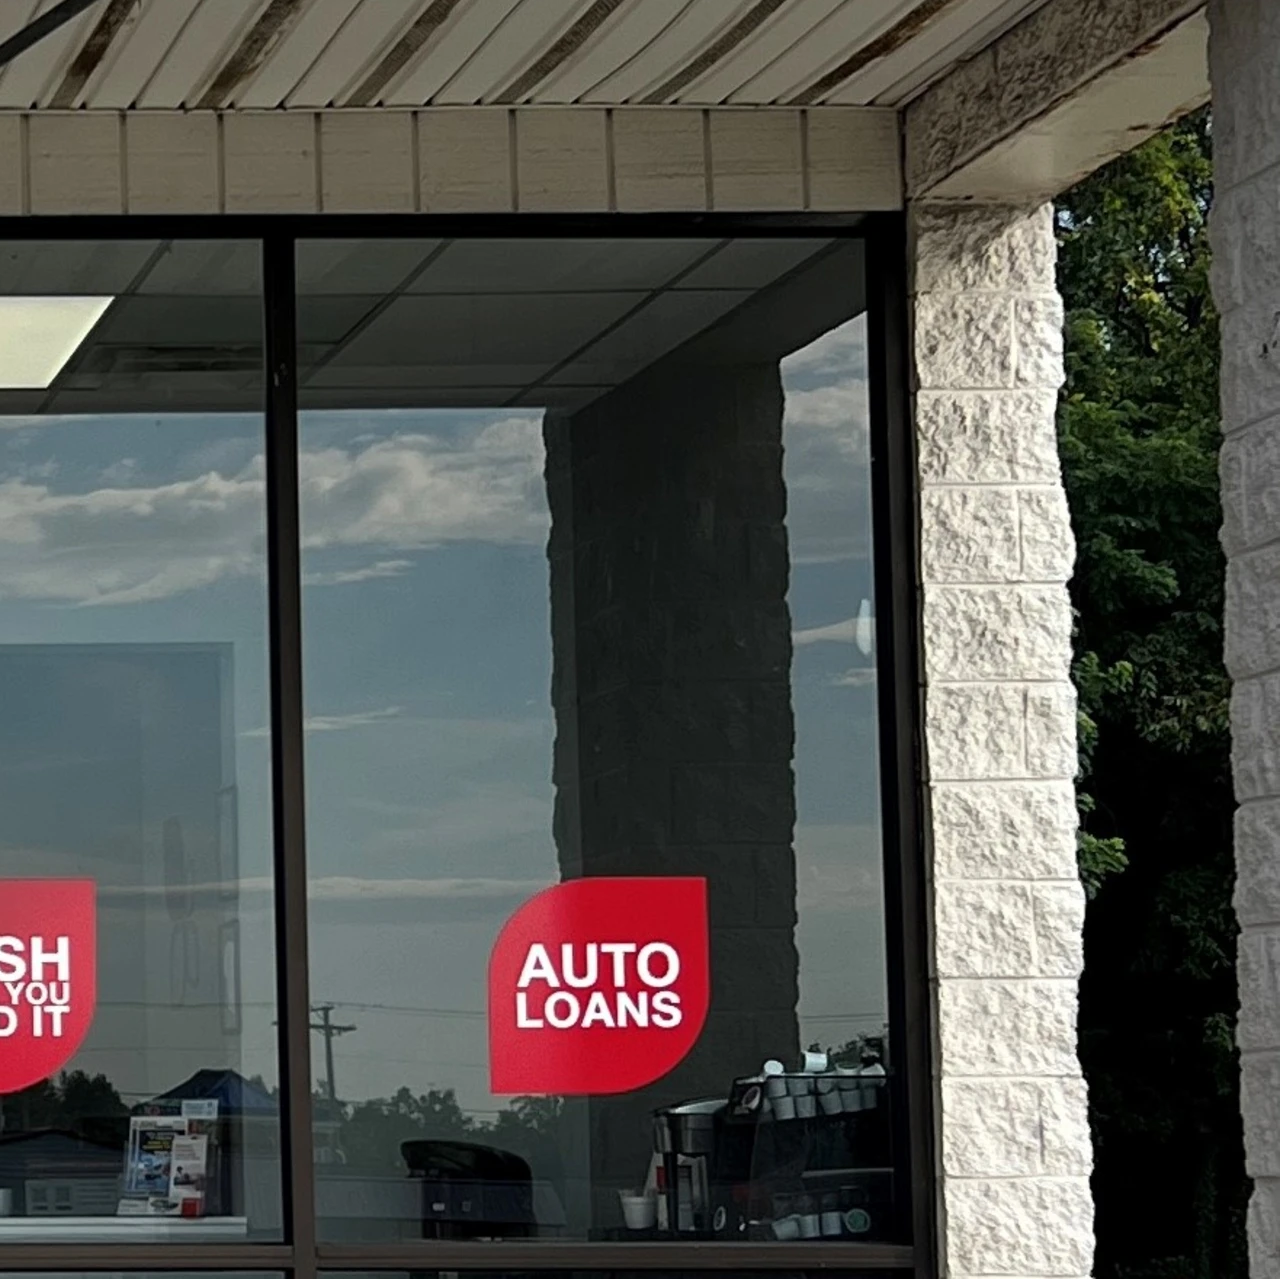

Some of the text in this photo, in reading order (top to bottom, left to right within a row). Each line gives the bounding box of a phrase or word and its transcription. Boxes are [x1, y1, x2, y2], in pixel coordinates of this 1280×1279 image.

[517, 942, 681, 988] AUTO
[4, 982, 71, 1005] YOU
[516, 991, 683, 1028] LOANS
[32, 1005, 71, 1037] IT
